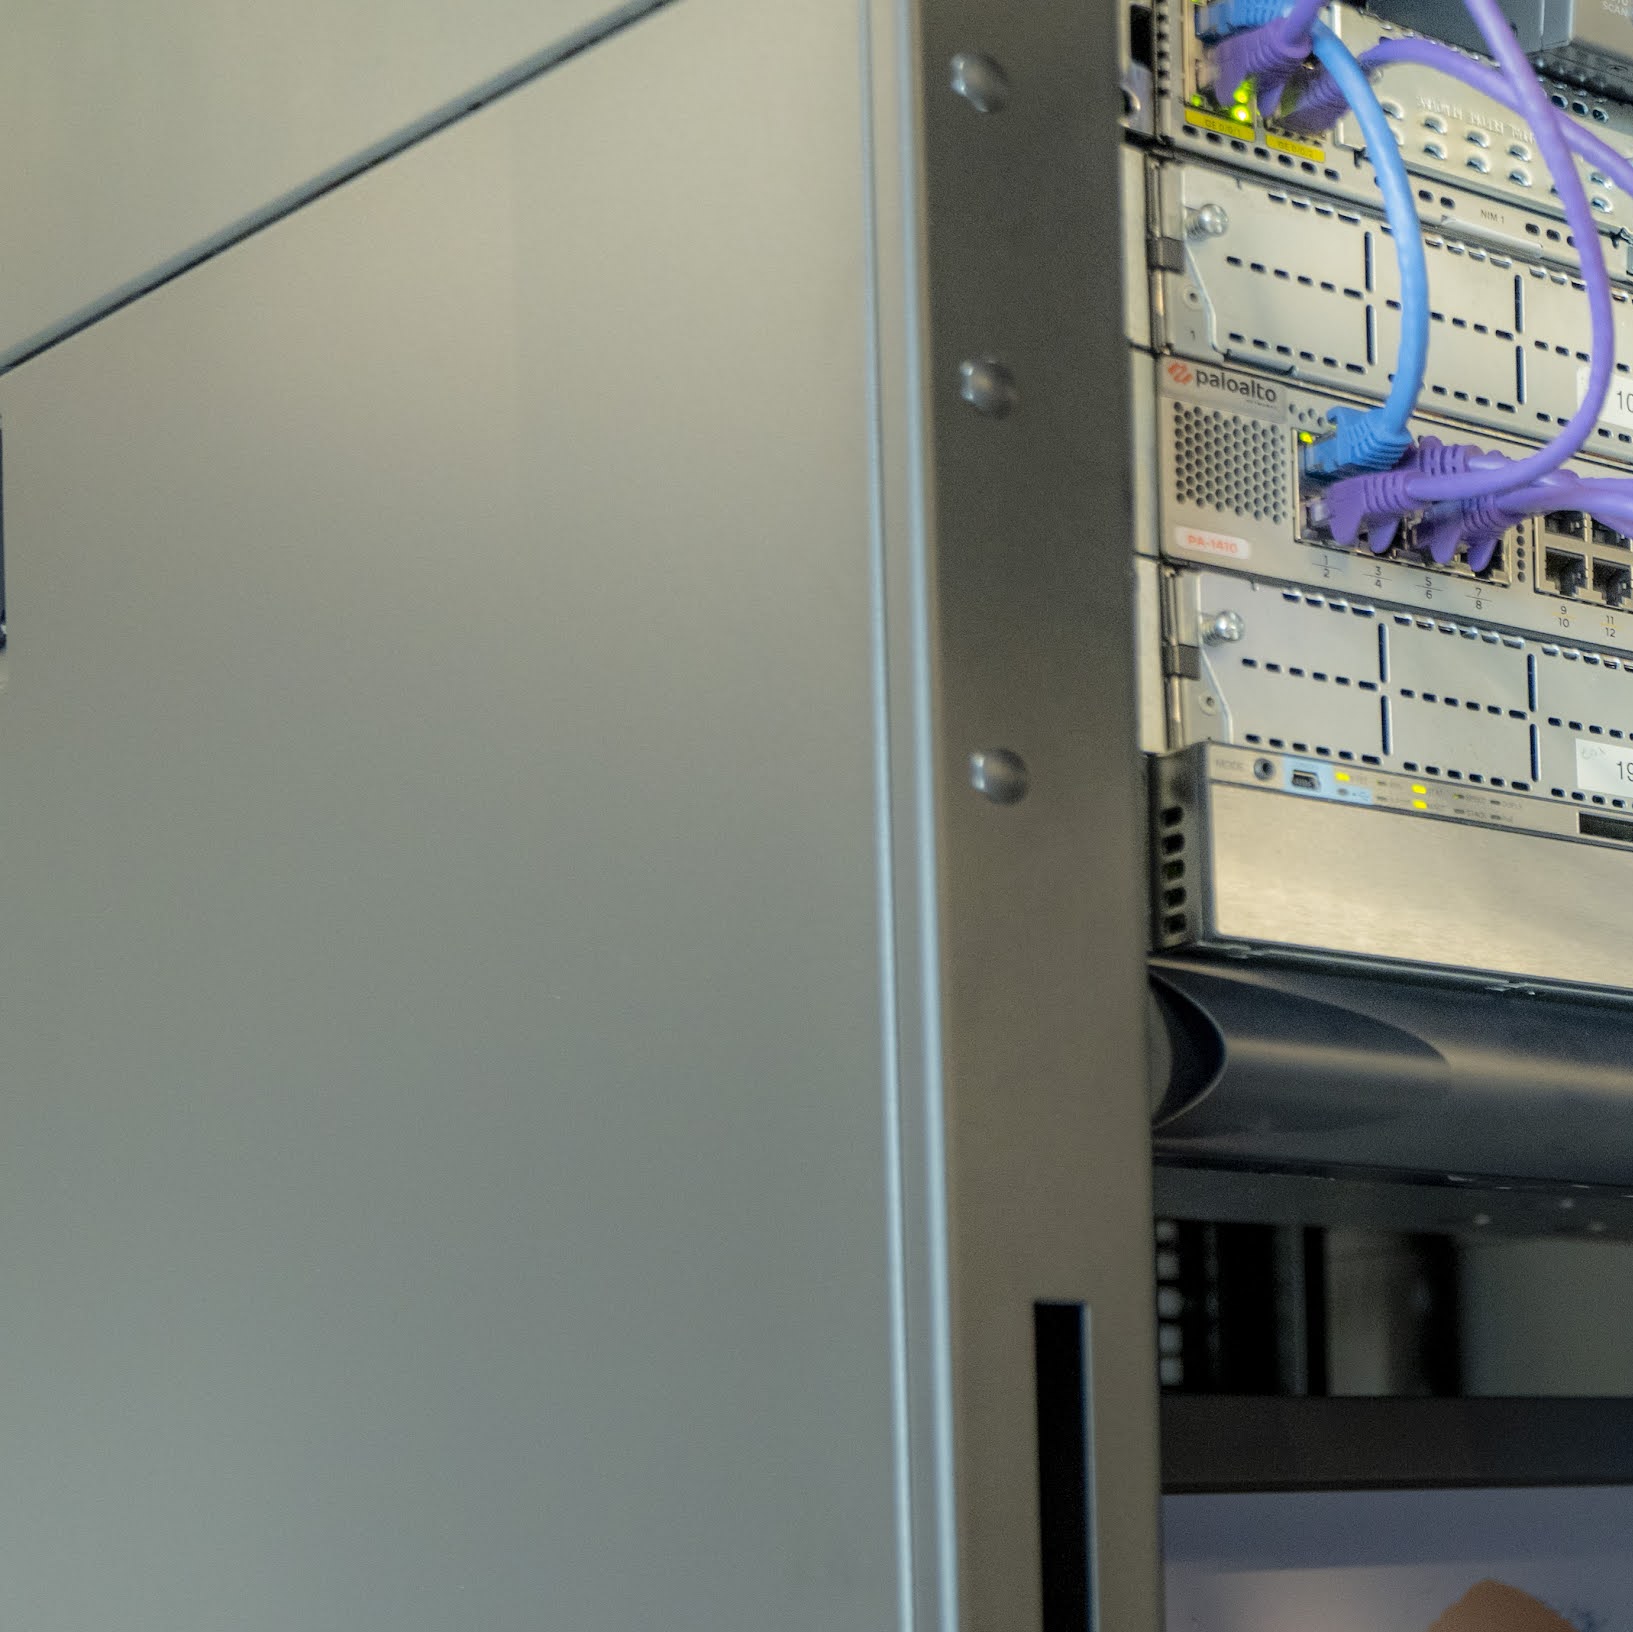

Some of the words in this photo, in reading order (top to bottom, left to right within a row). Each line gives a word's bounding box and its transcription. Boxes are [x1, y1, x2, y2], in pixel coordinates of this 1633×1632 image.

[1480, 209, 1498, 222] NIM
[1196, 369, 1277, 402] paloalto
[1187, 535, 1238, 554] PA-1410
[1558, 618, 1569, 628] 10
[1606, 615, 1614, 625] 11
[1605, 628, 1616, 638] 12
